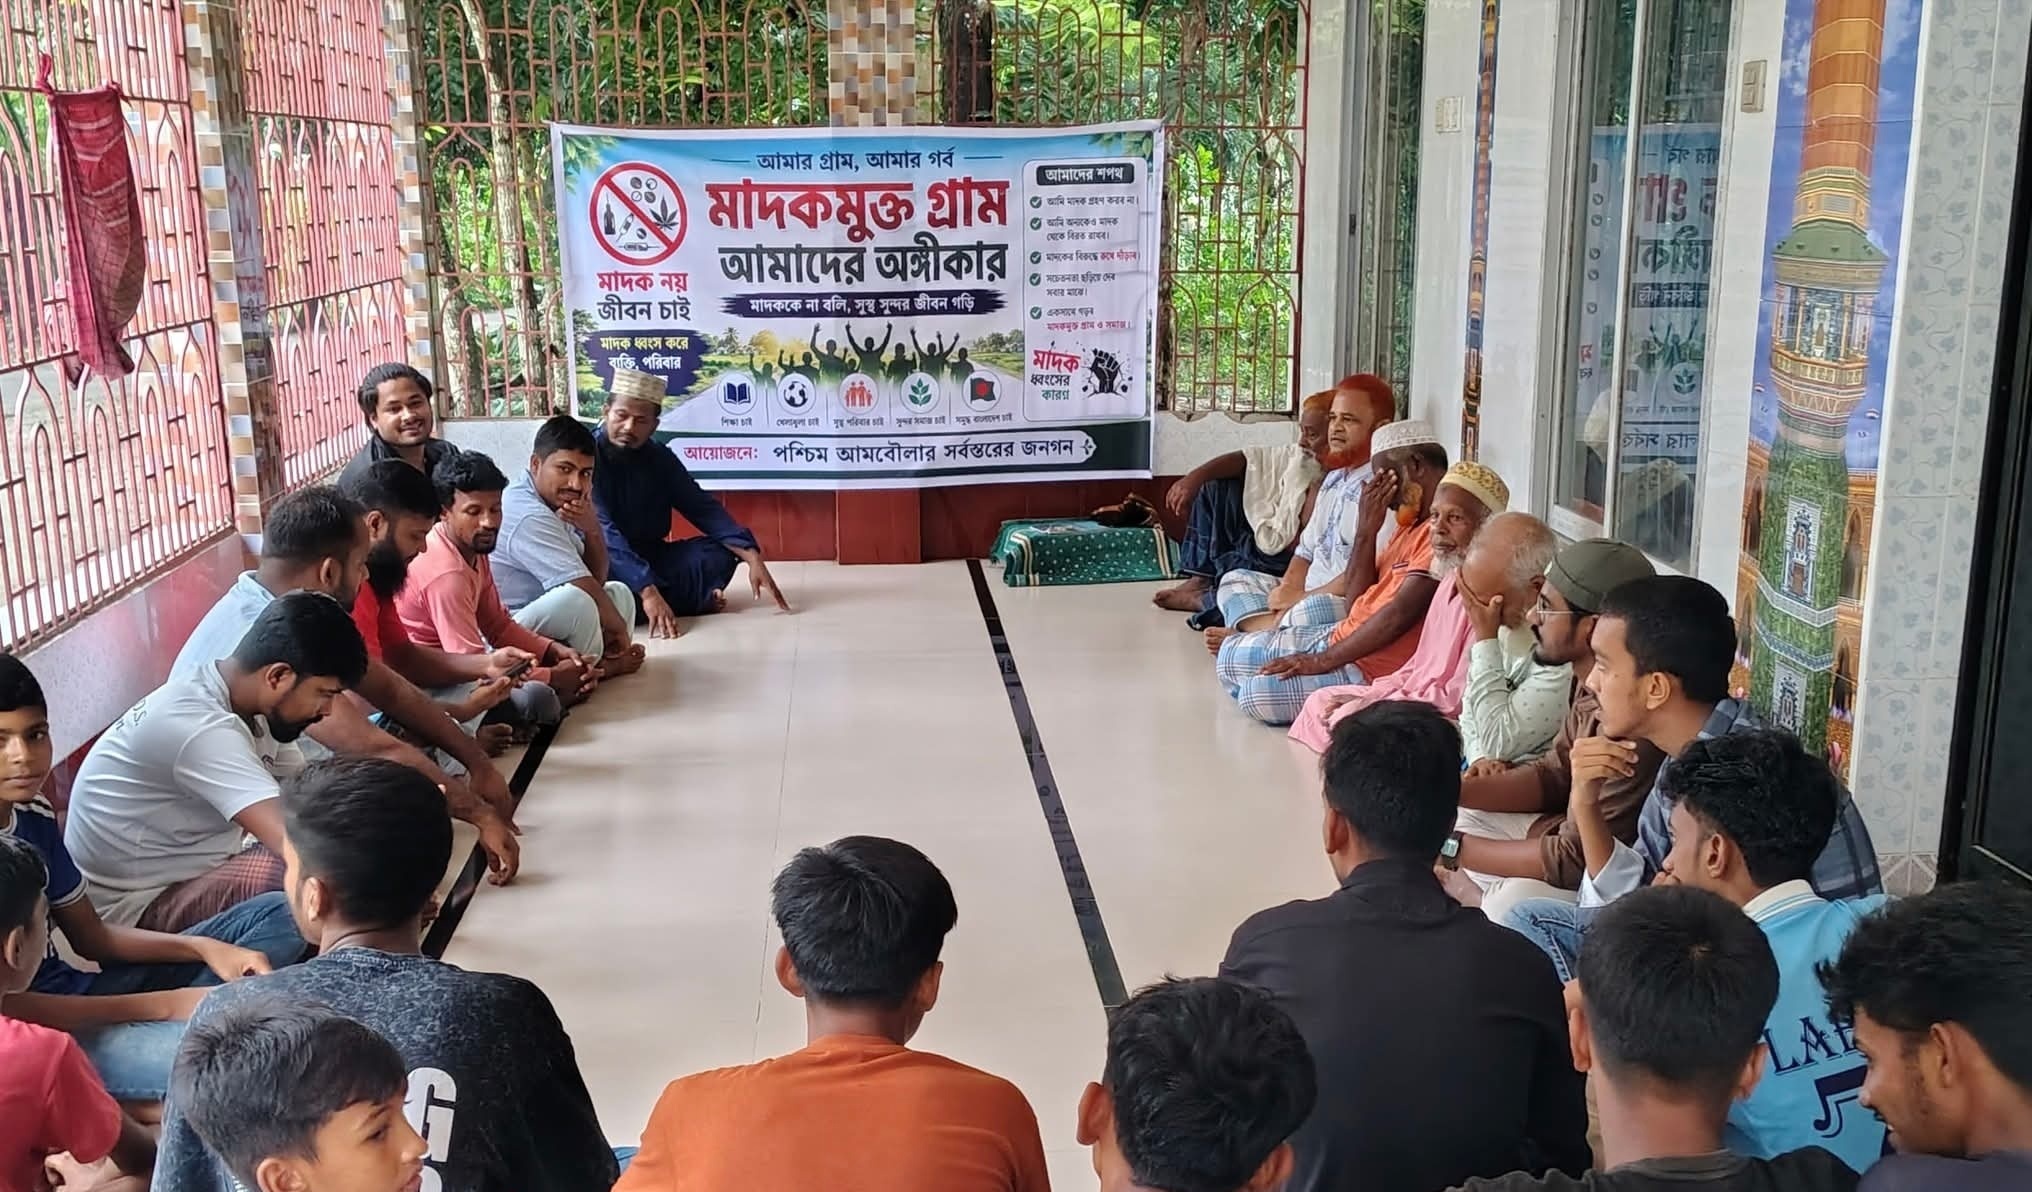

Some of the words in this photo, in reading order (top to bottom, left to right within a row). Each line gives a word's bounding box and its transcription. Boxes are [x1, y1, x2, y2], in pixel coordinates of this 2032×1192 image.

[757, 153, 812, 170] আমার
[820, 152, 860, 171] গ্রাম,
[866, 151, 921, 169] আমার
[928, 146, 956, 168] গর্ব
[1045, 167, 1093, 182] আমাদের
[1096, 167, 1124, 180] শপথ
[1047, 195, 1065, 206] আমি
[1067, 197, 1086, 206] মাদক
[705, 178, 914, 243] মাদকমুক্ত
[927, 176, 1010, 227] গ্রাম
[1047, 216, 1064, 227] আমি
[1099, 218, 1119, 226] মাদক
[1047, 232, 1065, 241] থেকে
[1067, 229, 1086, 240] বিরত
[718, 244, 866, 285] আমাদের
[874, 231, 1008, 282] অঙ্গীকার
[597, 271, 654, 292] মাদক
[659, 273, 689, 293] নয়
[597, 294, 652, 320] জীবন
[658, 295, 691, 320] চাই
[749, 299, 802, 313] মাদককে
[805, 299, 820, 312] না
[823, 296, 851, 313] বলি,
[854, 298, 877, 315] সুস্থ
[879, 298, 911, 315] সুন্দর
[914, 294, 949, 310] জীবন
[952, 292, 976, 312] গড়ি
[1081, 321, 1095, 329] গ্রাম
[600, 337, 632, 350] মাদক
[634, 337, 662, 350] ধ্বংস
[664, 337, 689, 350] করে
[608, 353, 639, 371] ব্যক্তি,
[642, 353, 682, 370] পরিবার
[1033, 350, 1081, 373] মাদক
[1031, 374, 1070, 387] ধ্বংসের
[741, 418, 752, 426] চাই
[808, 418, 819, 426] চাই
[873, 417, 884, 426] চাই
[935, 416, 946, 425] চাই
[1002, 413, 1012, 422] চাই
[684, 447, 758, 460] আয়োজনে:
[773, 441, 828, 462] পশ্চিম
[836, 441, 936, 463] আমবৌলার
[944, 438, 1015, 460] সর্বস্তরের
[1021, 440, 1073, 456] জনগন
